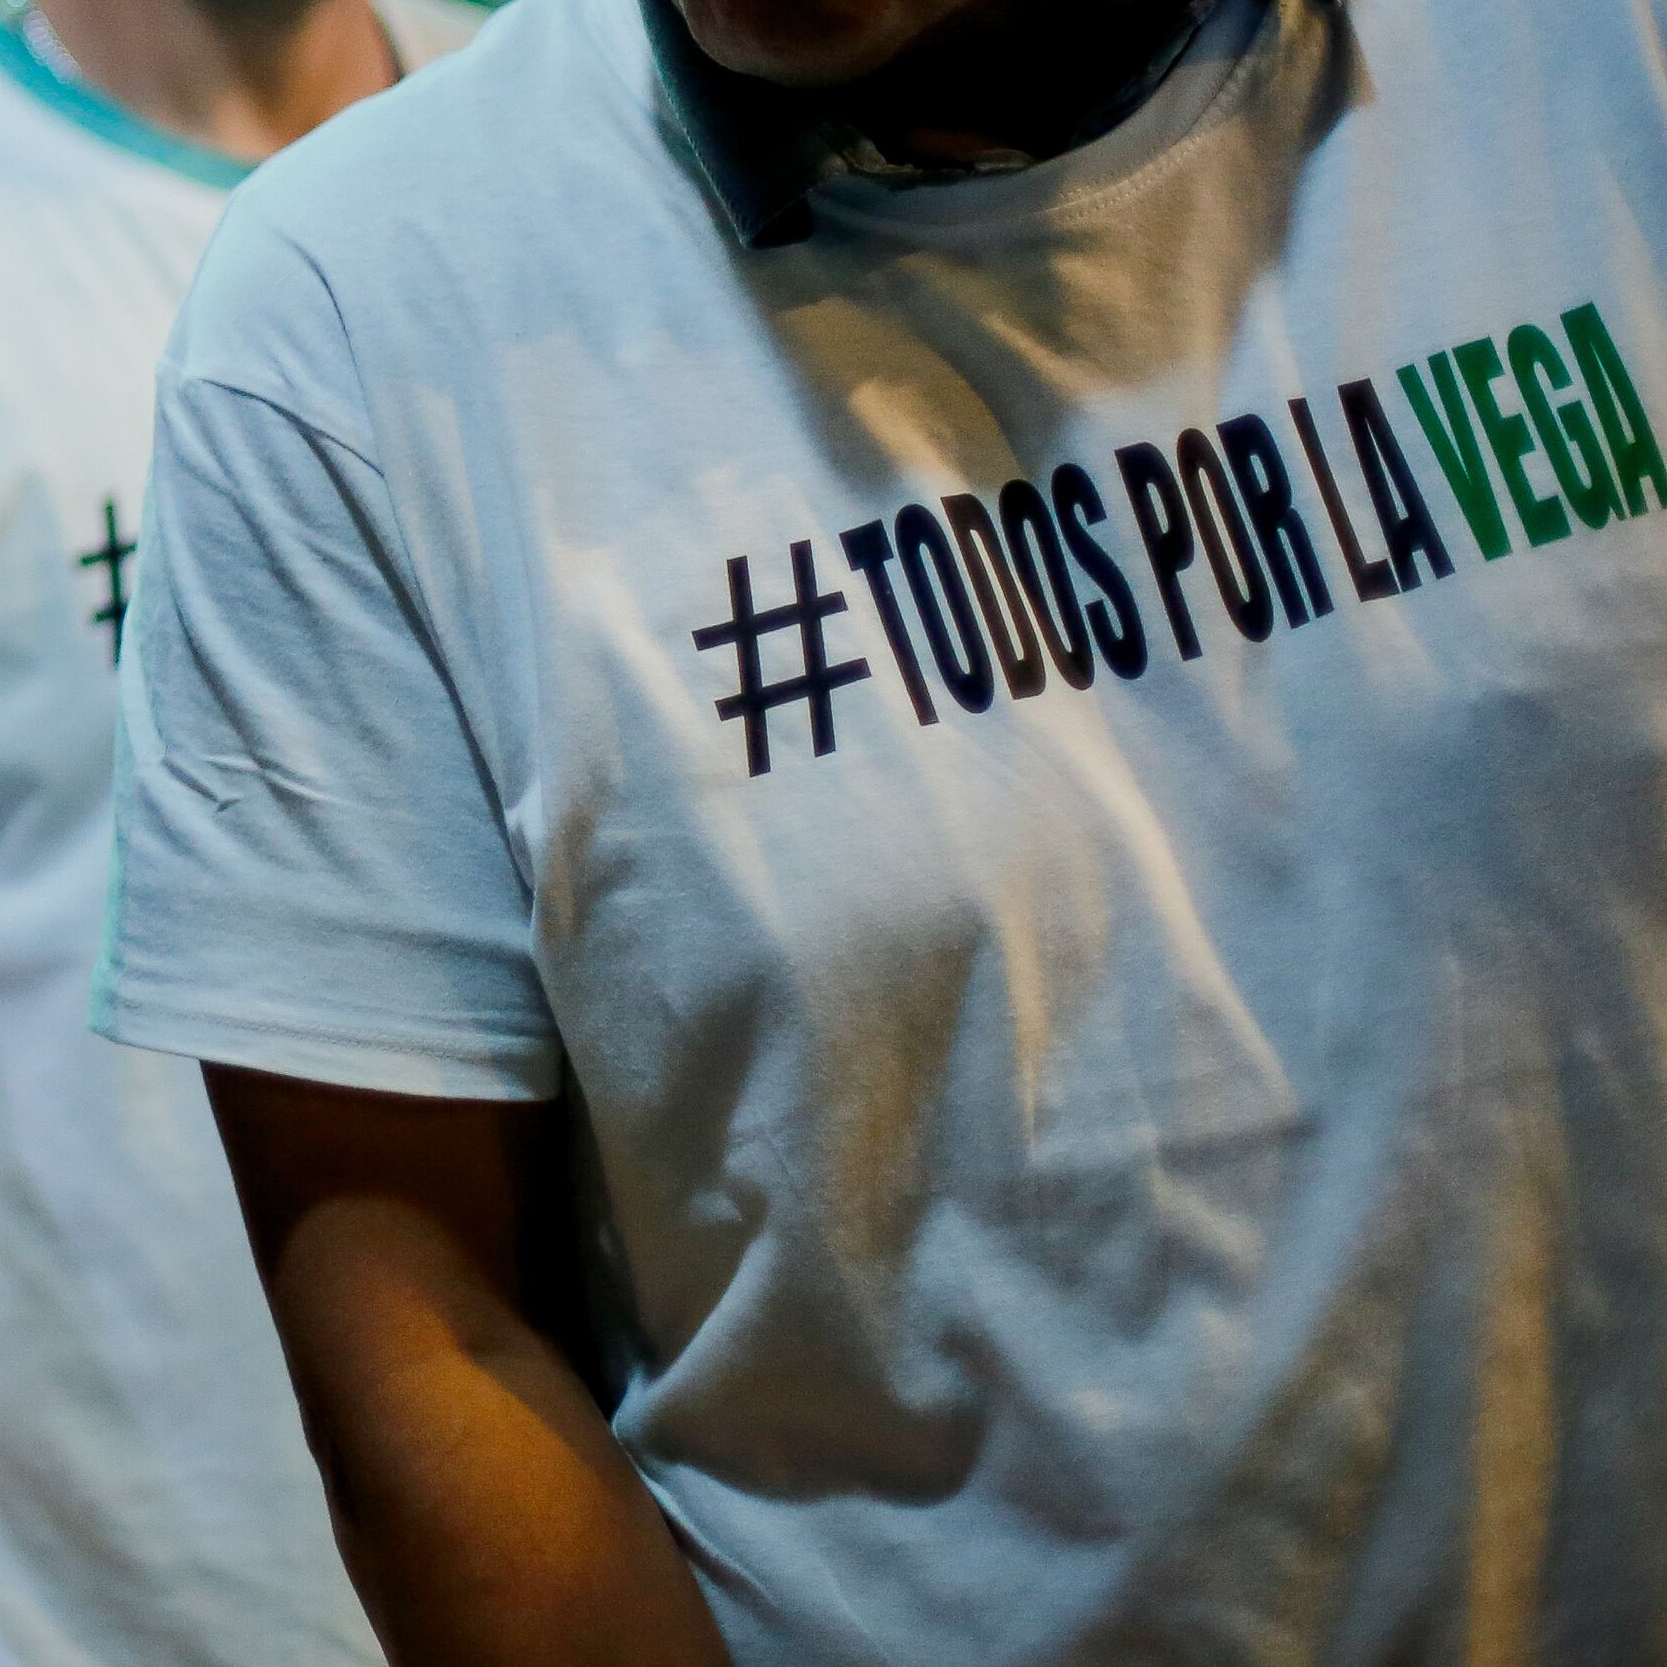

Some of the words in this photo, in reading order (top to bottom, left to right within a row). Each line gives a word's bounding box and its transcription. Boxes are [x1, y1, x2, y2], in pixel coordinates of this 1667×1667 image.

[692, 463, 1149, 777] #TODOS
[1115, 413, 1334, 660] POR
[1287, 377, 1456, 603] LA
[1396, 301, 1667, 562] VEGA
